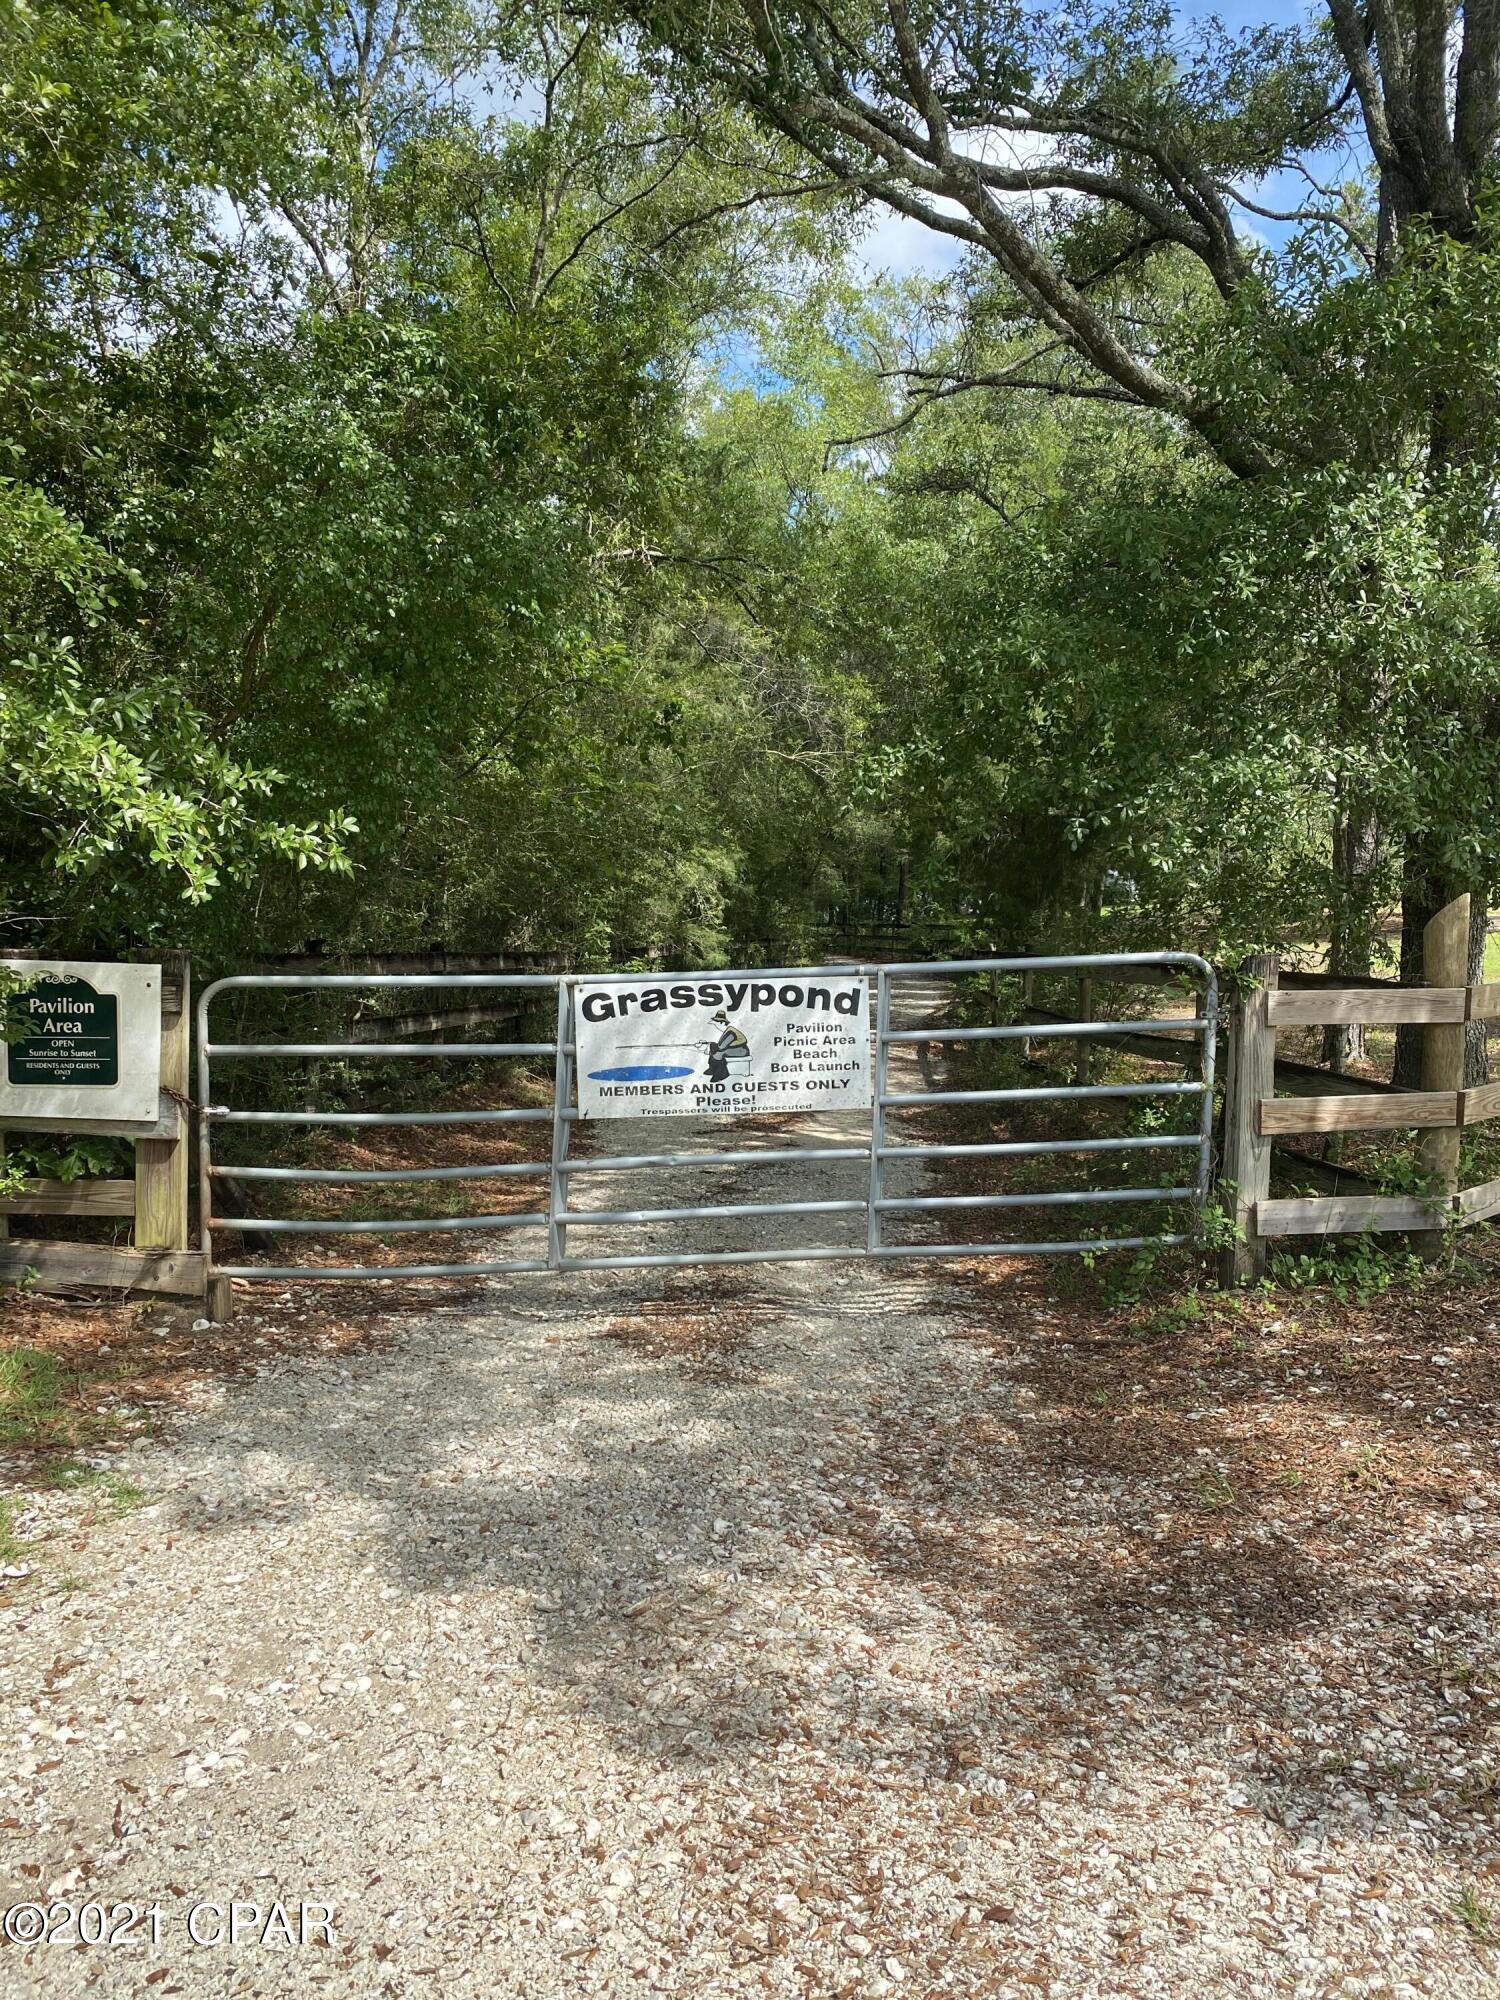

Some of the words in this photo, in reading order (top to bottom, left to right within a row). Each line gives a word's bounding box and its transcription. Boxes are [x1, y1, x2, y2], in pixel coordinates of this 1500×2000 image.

[29, 998, 94, 1014] Pavilion
[582, 984, 861, 1022] Grassypond
[43, 1018, 82, 1033] Area
[787, 1023, 843, 1033] Pavilion
[774, 1036, 818, 1046] Picnic
[822, 1035, 856, 1045] Area
[29, 1049, 58, 1057] Sunrise
[793, 1048, 837, 1059] Beach
[771, 1062, 803, 1072] Boat
[809, 1061, 860, 1071] Launch
[599, 1085, 684, 1097] MEMBERS
[690, 1083, 726, 1093] AND
[732, 1081, 800, 1093] GUESTS
[806, 1079, 851, 1090] ONLY
[696, 1095, 756, 1106] Please!
[640, 1107, 708, 1115] Trespassers
[751, 1103, 812, 1112] prosecuted
